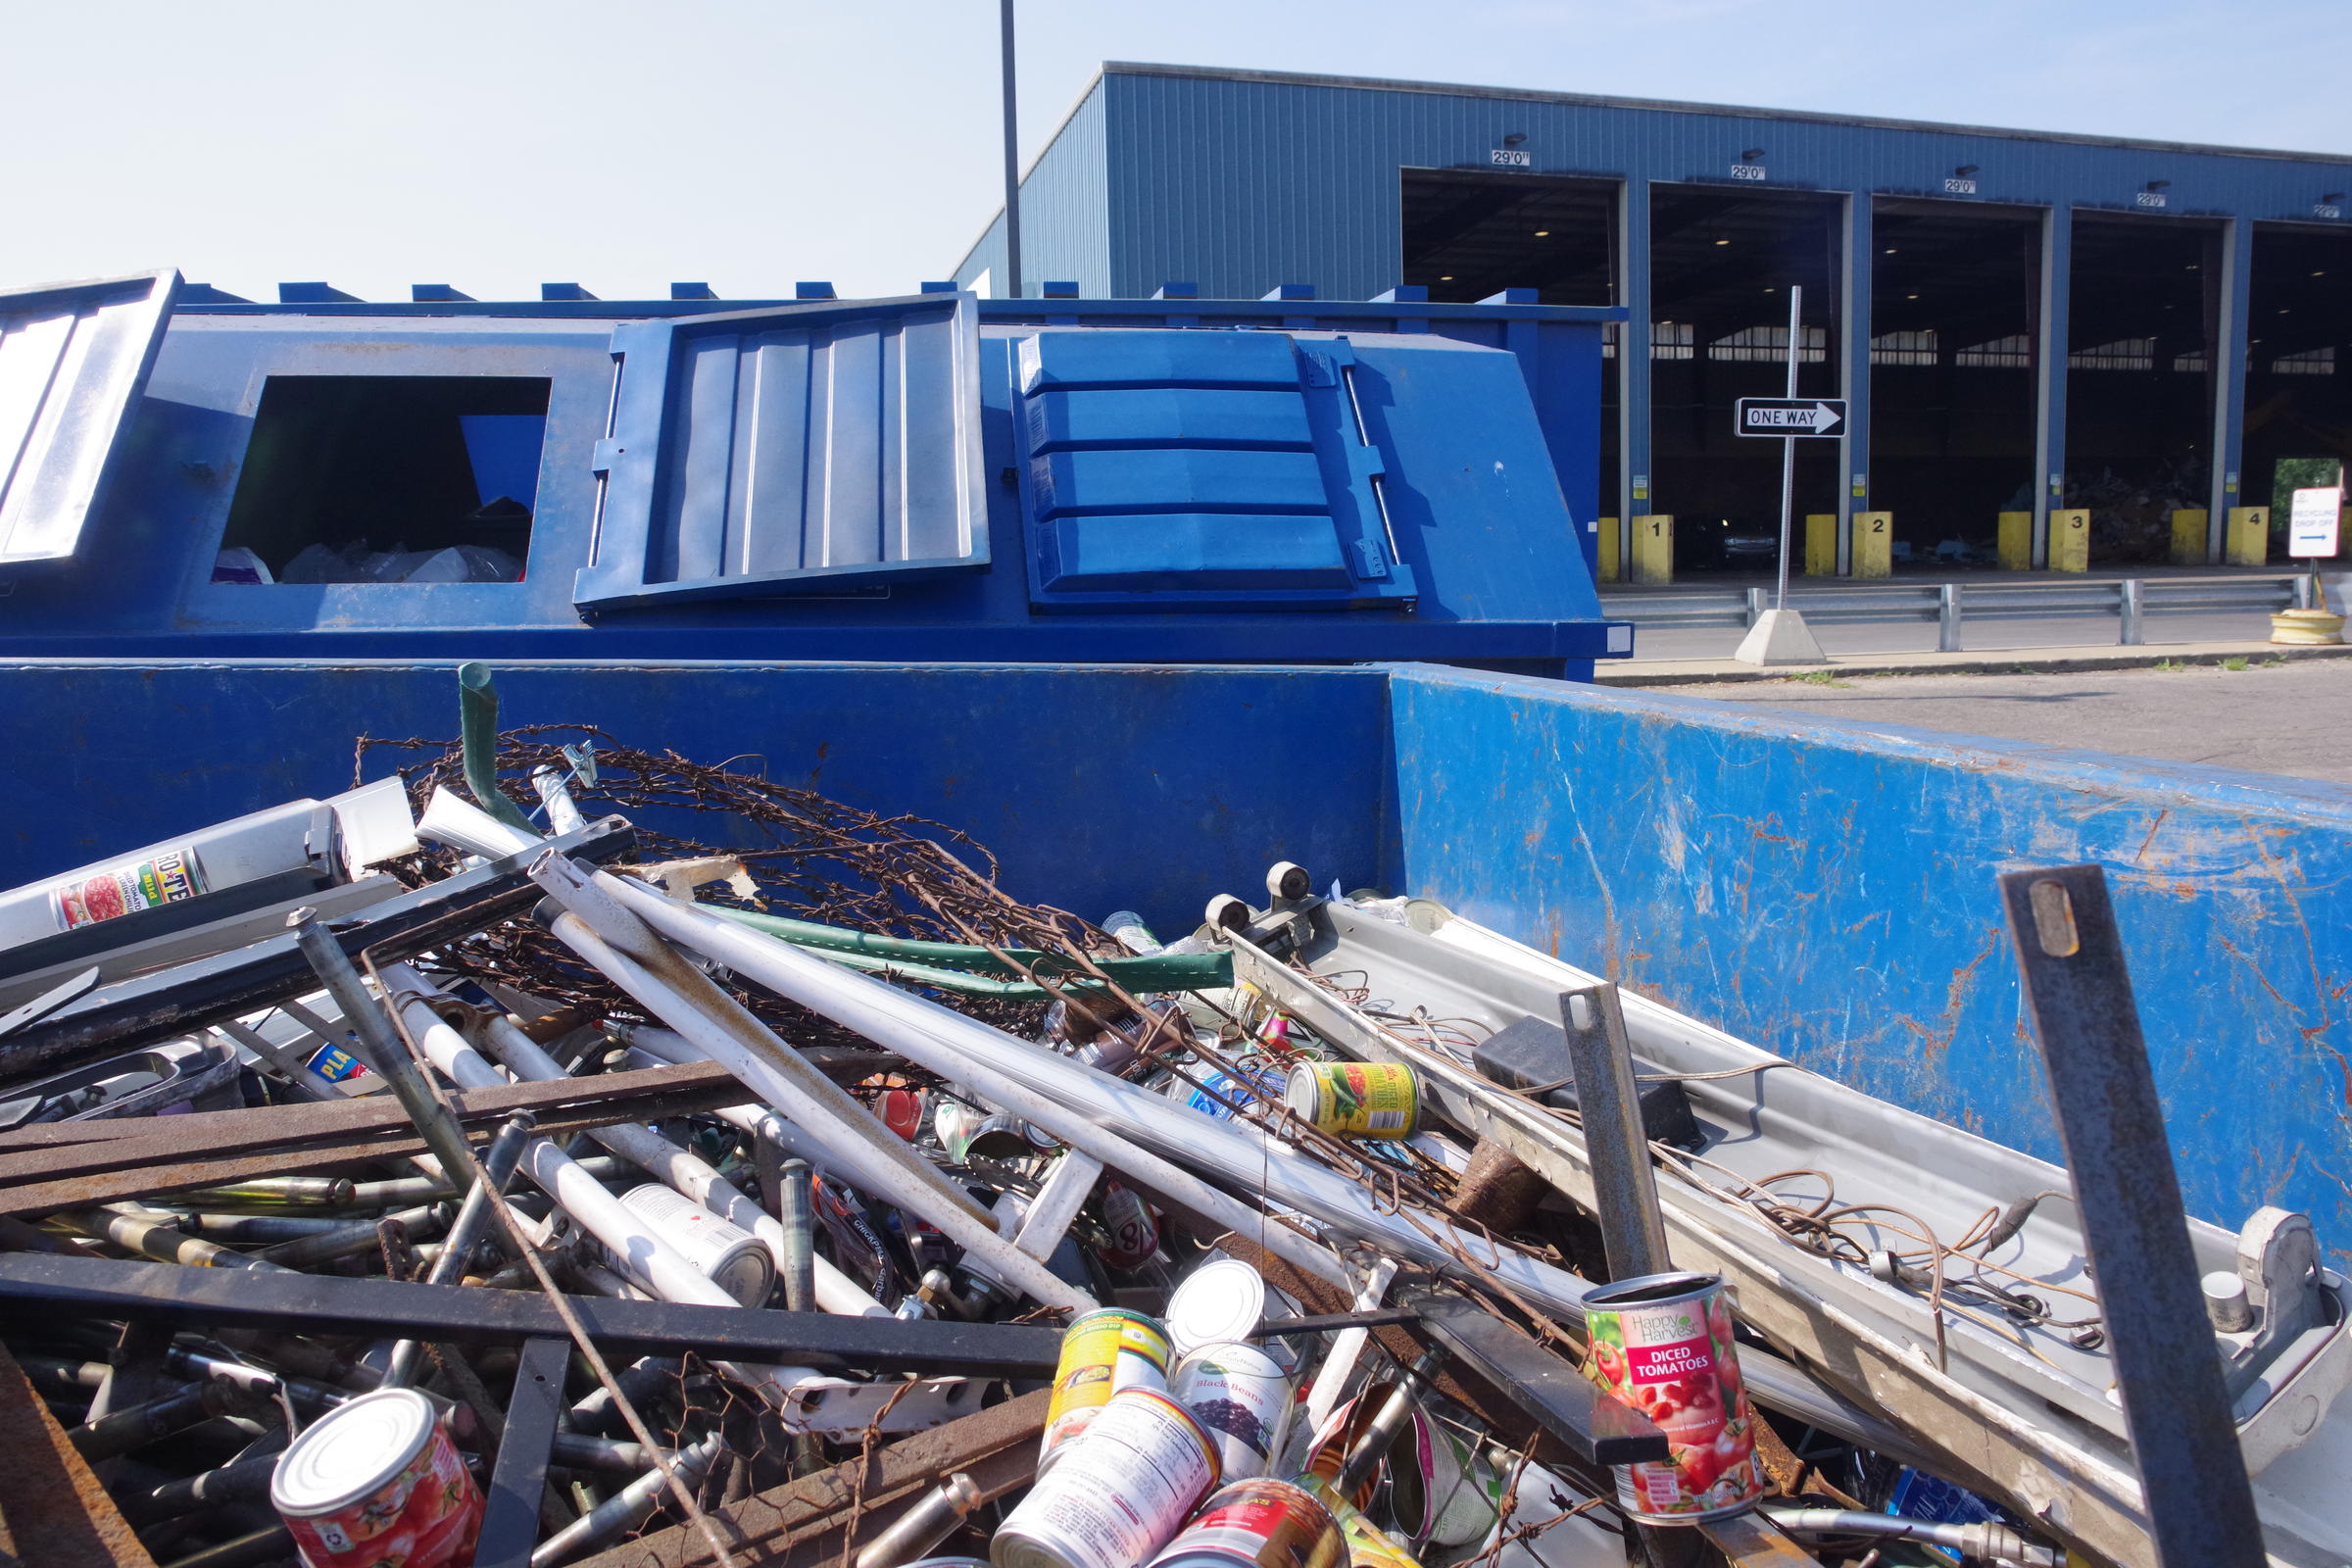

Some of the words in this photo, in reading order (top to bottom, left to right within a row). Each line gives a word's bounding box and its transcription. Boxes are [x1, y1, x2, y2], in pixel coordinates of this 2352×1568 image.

[1494, 151, 1529, 165] 29'0"
[1732, 166, 1765, 178] 29'0"
[1751, 411, 1781, 424] ONE
[1787, 411, 1817, 424] WAY
[1873, 519, 1884, 533] 2
[2072, 515, 2082, 529] 3
[2249, 513, 2260, 525] 4
[1652, 522, 1660, 537] 1
[143, 873, 157, 900] Mild
[1388, 1083, 1397, 1108] DICED
[1632, 1313, 1679, 1330] Happy
[1642, 1322, 1700, 1342] Harvest
[1650, 1347, 1691, 1363] DICED
[1637, 1355, 1709, 1377] TOMATOES
[1196, 1379, 1228, 1389] Black
[1231, 1383, 1264, 1405] Beans
